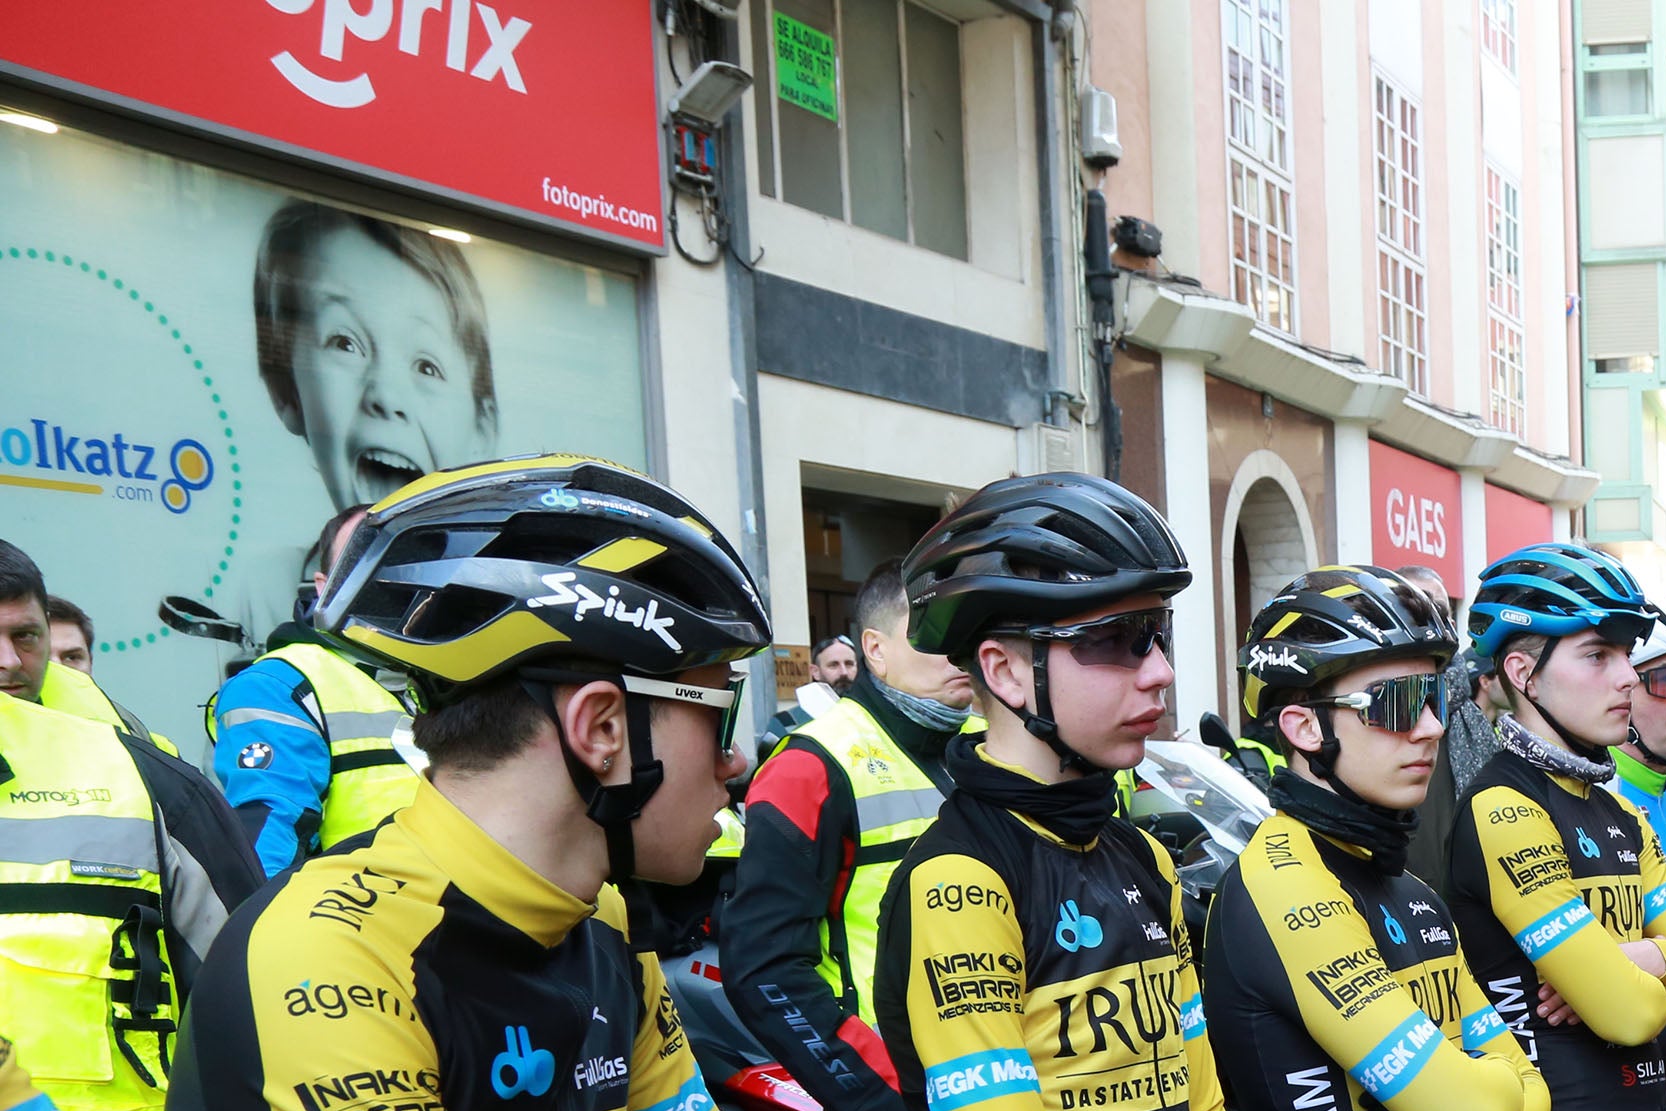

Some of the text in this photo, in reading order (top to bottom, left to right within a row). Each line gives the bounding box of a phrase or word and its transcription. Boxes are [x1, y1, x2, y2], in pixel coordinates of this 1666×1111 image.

[281, 0, 533, 95] prix
[541, 176, 658, 232] fotoprix.com
[111, 483, 154, 502] .com
[1386, 488, 1446, 559] GAES
[528, 571, 684, 655] Spiuk
[1346, 613, 1385, 645] Spiuk
[1503, 611, 1530, 625] ABUS
[1247, 644, 1309, 676] Spiuk
[675, 687, 704, 701] uvex
[1531, 920, 1568, 949] EGK
[1375, 1041, 1414, 1085] EGK
[933, 1064, 987, 1101] EGK
